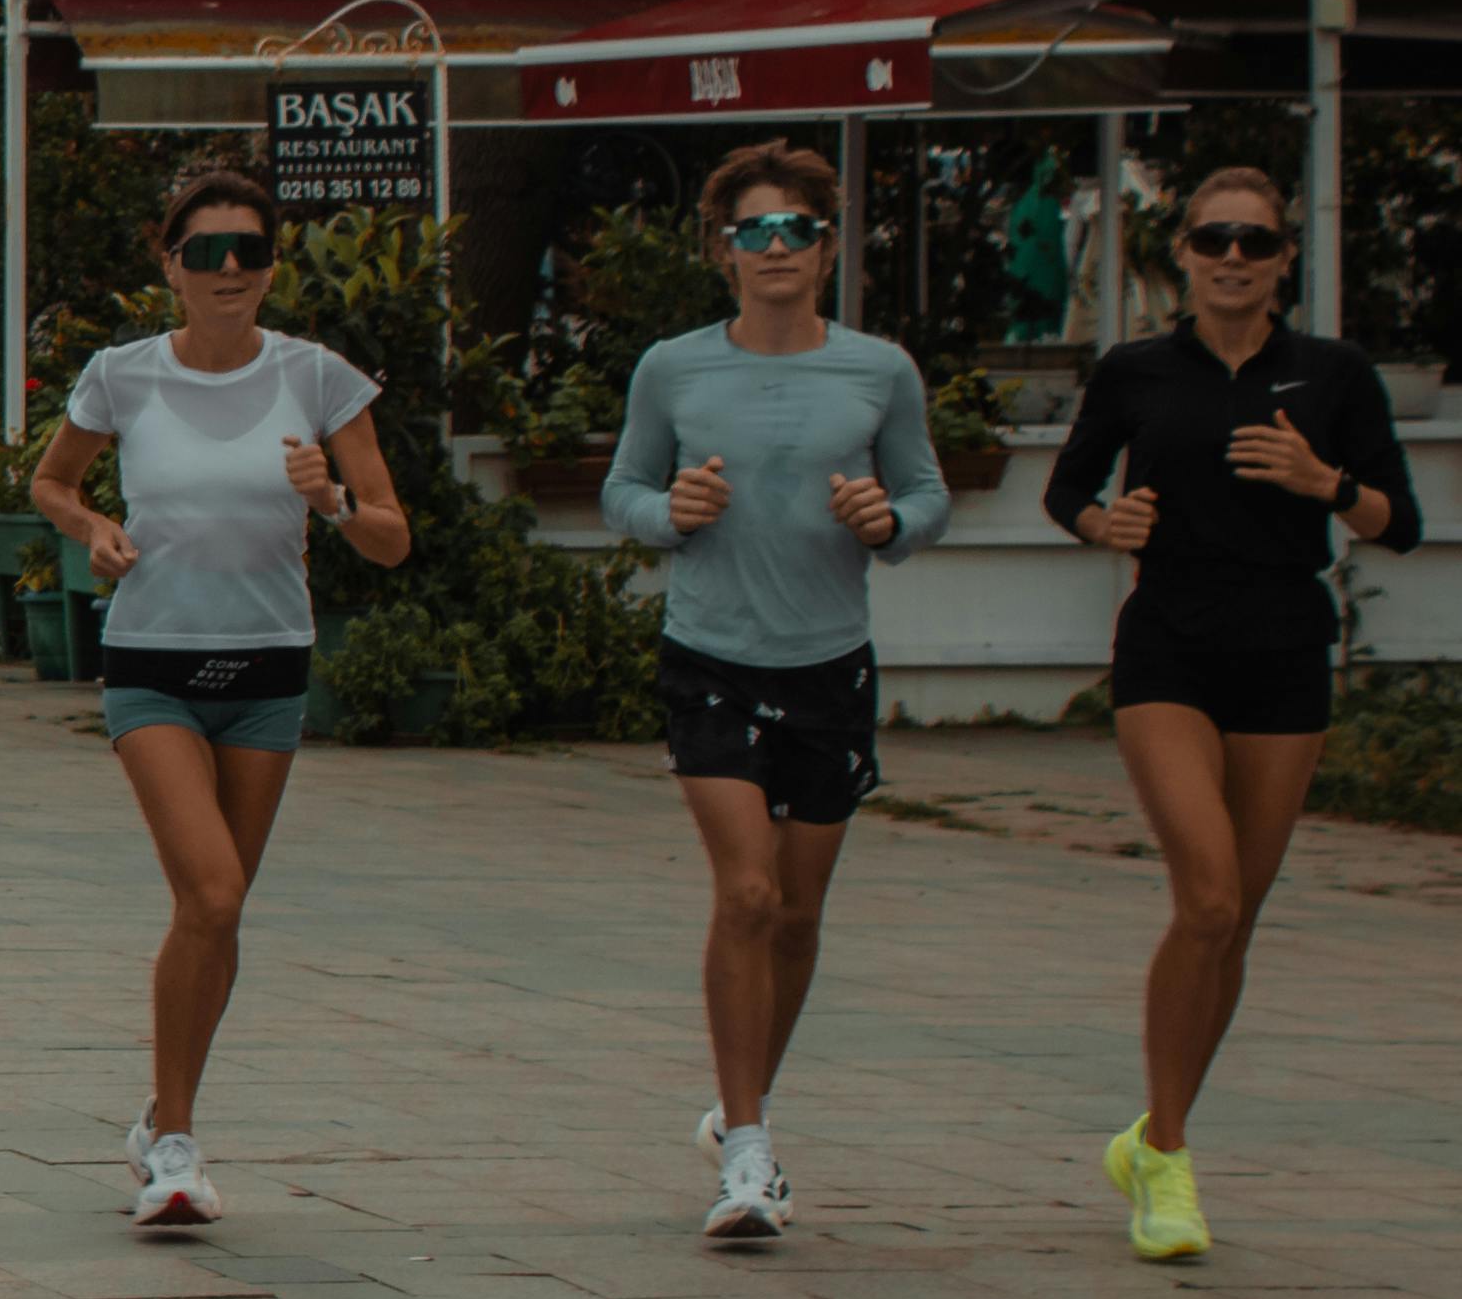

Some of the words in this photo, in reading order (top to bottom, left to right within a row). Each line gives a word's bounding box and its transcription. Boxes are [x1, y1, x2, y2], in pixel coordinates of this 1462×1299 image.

[276, 92, 418, 137] BAŞAK
[276, 139, 419, 158] RESTAURANT
[278, 180, 326, 200] 0216
[330, 179, 362, 199] 351
[369, 179, 393, 198] 12
[396, 178, 422, 197] 89
[205, 659, 250, 670] COMP
